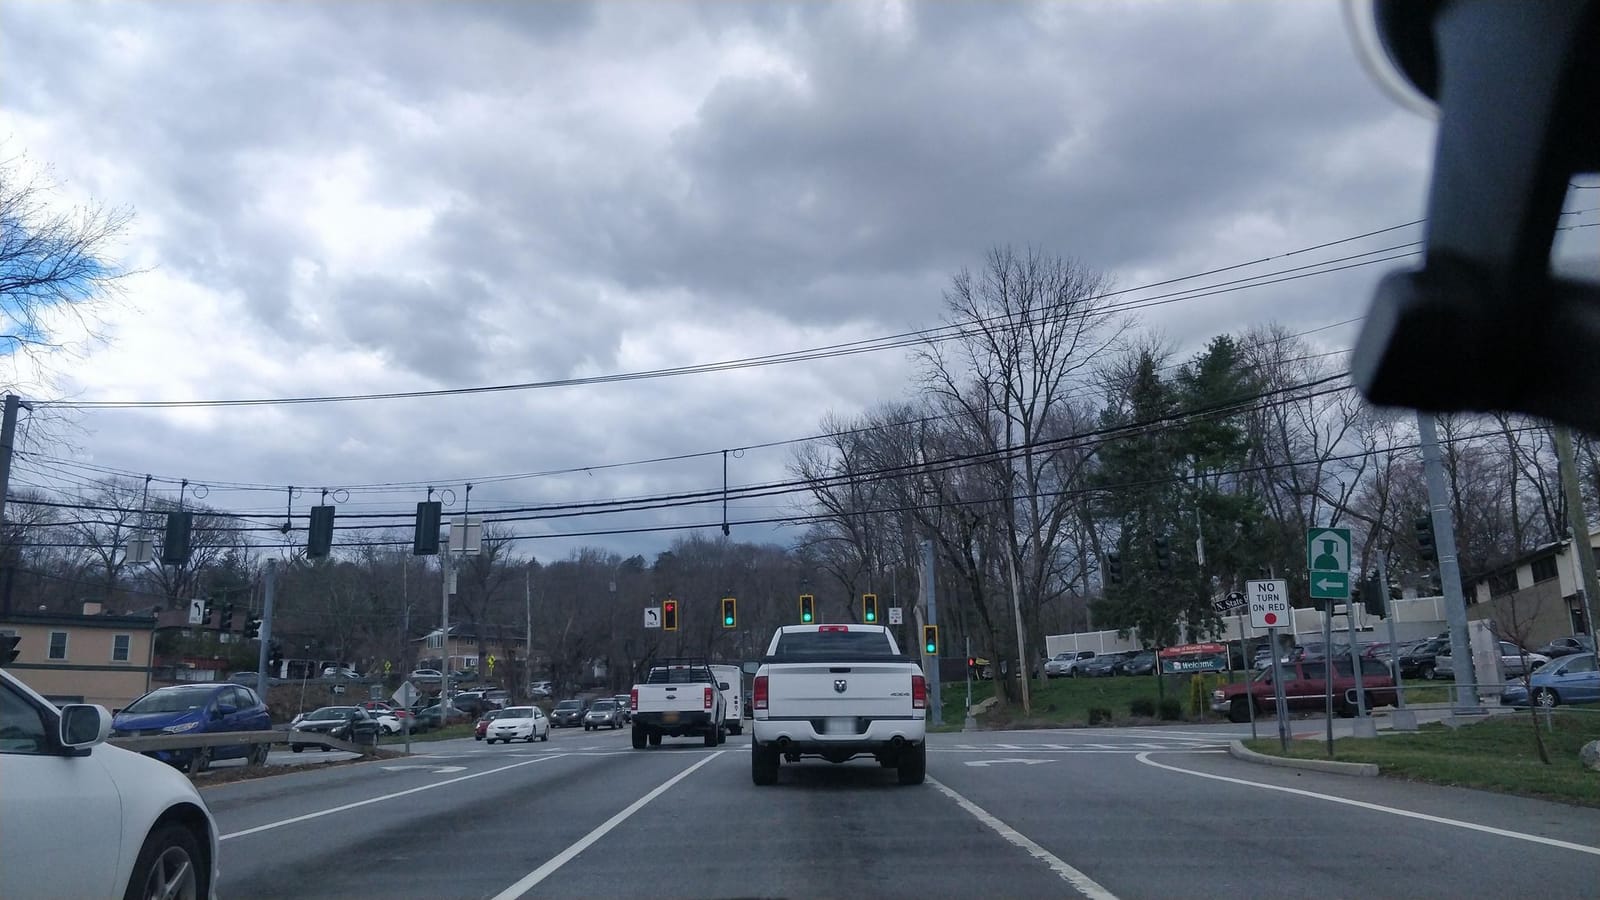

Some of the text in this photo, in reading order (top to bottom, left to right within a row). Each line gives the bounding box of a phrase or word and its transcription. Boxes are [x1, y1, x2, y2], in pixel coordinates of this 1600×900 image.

[1258, 583, 1275, 592] NO
[1256, 593, 1280, 602] TURN
[1225, 599, 1243, 609] State
[1268, 603, 1285, 611] RED
[1182, 661, 1214, 669] Welcome
